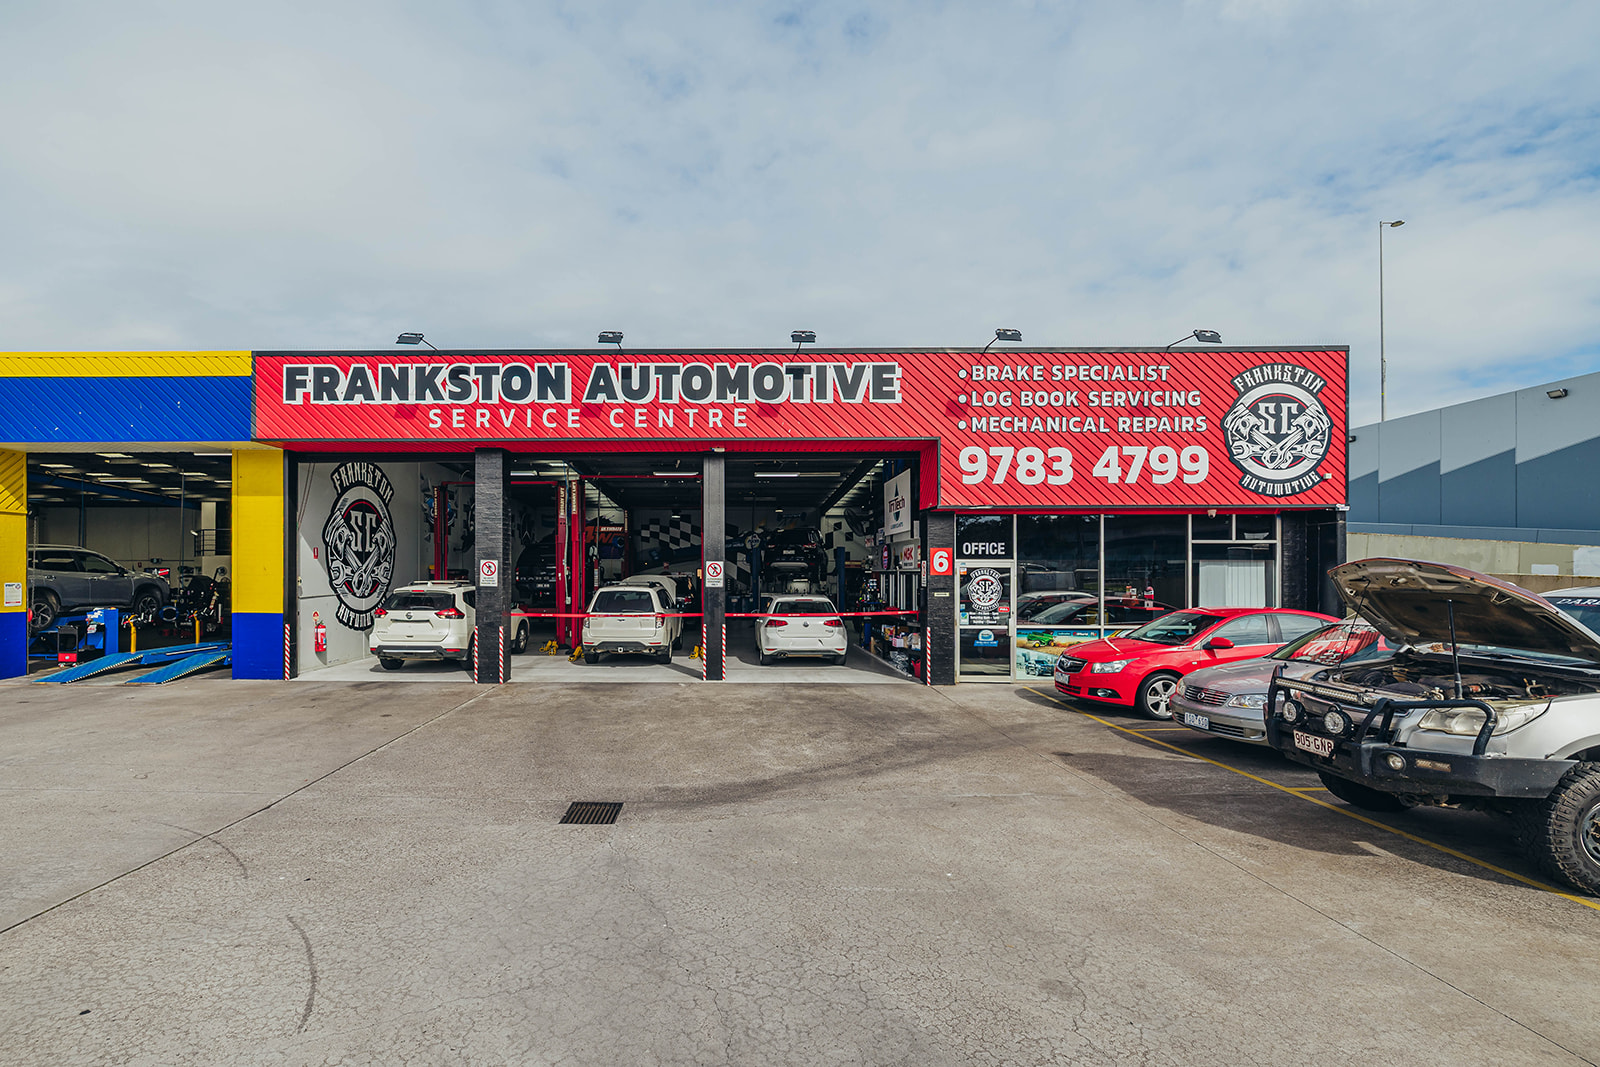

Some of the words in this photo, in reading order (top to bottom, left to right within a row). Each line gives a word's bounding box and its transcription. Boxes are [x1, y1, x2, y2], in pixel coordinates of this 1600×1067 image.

[283, 363, 571, 404] FRANKSTON
[583, 362, 902, 404] AUTOMOTIVE
[971, 365, 1045, 381] BRAKE
[1051, 365, 1170, 381] SPECIALIST
[1233, 364, 1325, 393] FRANKSTON
[971, 390, 1013, 407] LOG
[1020, 390, 1080, 407] BOOK
[1087, 390, 1202, 407] SERVICING
[428, 408, 581, 428] SERVICE
[609, 408, 748, 428] CENTRE
[971, 416, 1110, 433] MECHANICAL
[1117, 416, 1208, 433] REPAIRS
[1257, 402, 1300, 435] SC
[958, 446, 1074, 485] 9783
[1092, 445, 1210, 484] 4799
[332, 462, 393, 504] FRANKSTON
[1241, 470, 1321, 496] AUTOMOTIVE
[963, 542, 1005, 555] OFFICE
[933, 551, 949, 573] 6
